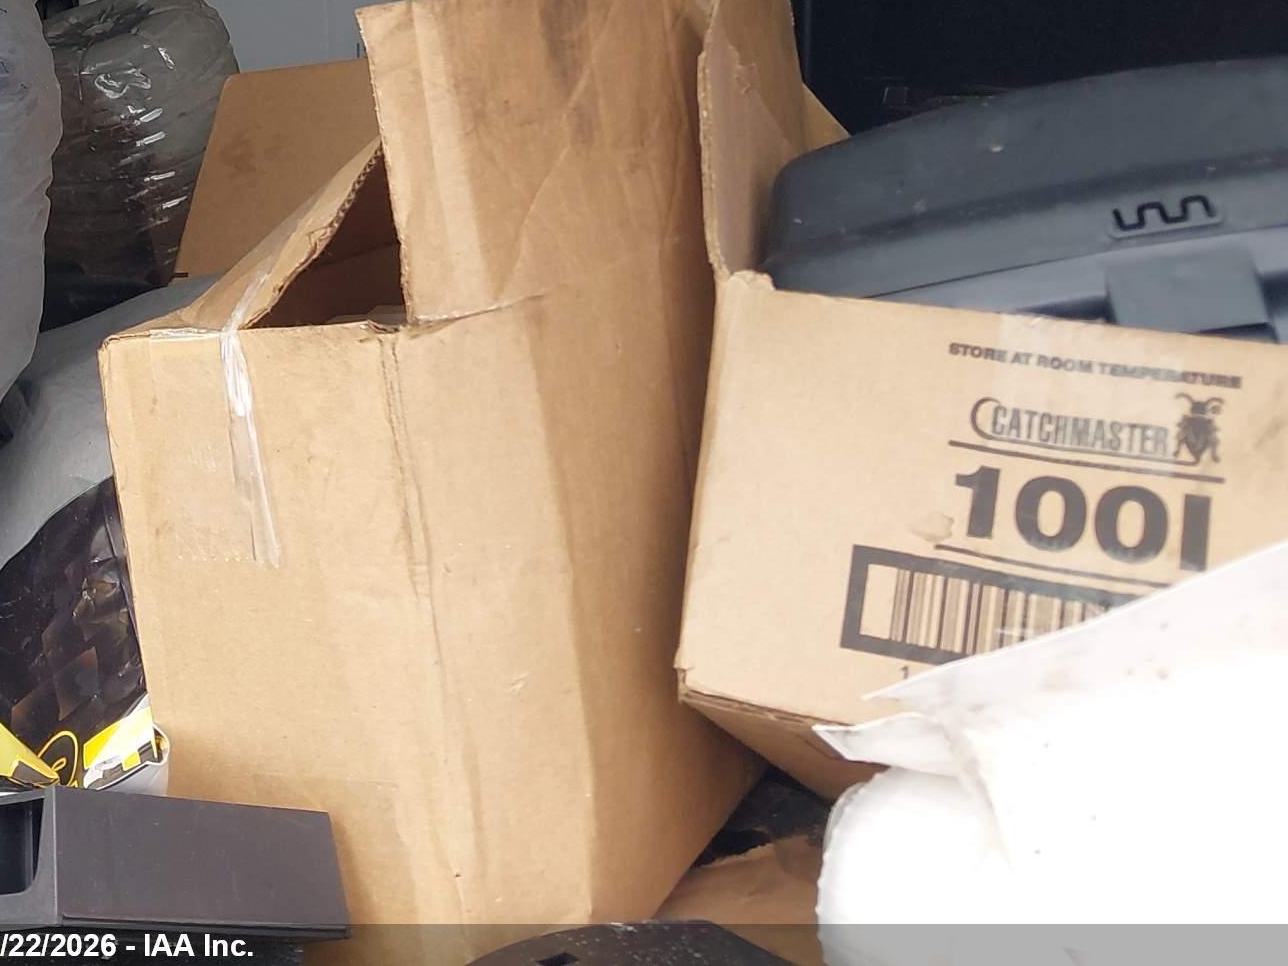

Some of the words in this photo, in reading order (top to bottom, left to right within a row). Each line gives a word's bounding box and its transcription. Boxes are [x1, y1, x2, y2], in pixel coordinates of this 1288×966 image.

[949, 342, 1008, 362] STORE
[1011, 351, 1032, 365] AT
[1036, 354, 1093, 373] ROOM
[1099, 362, 1242, 389] TEMPERATURE
[989, 402, 1173, 461] CATCHMASTER
